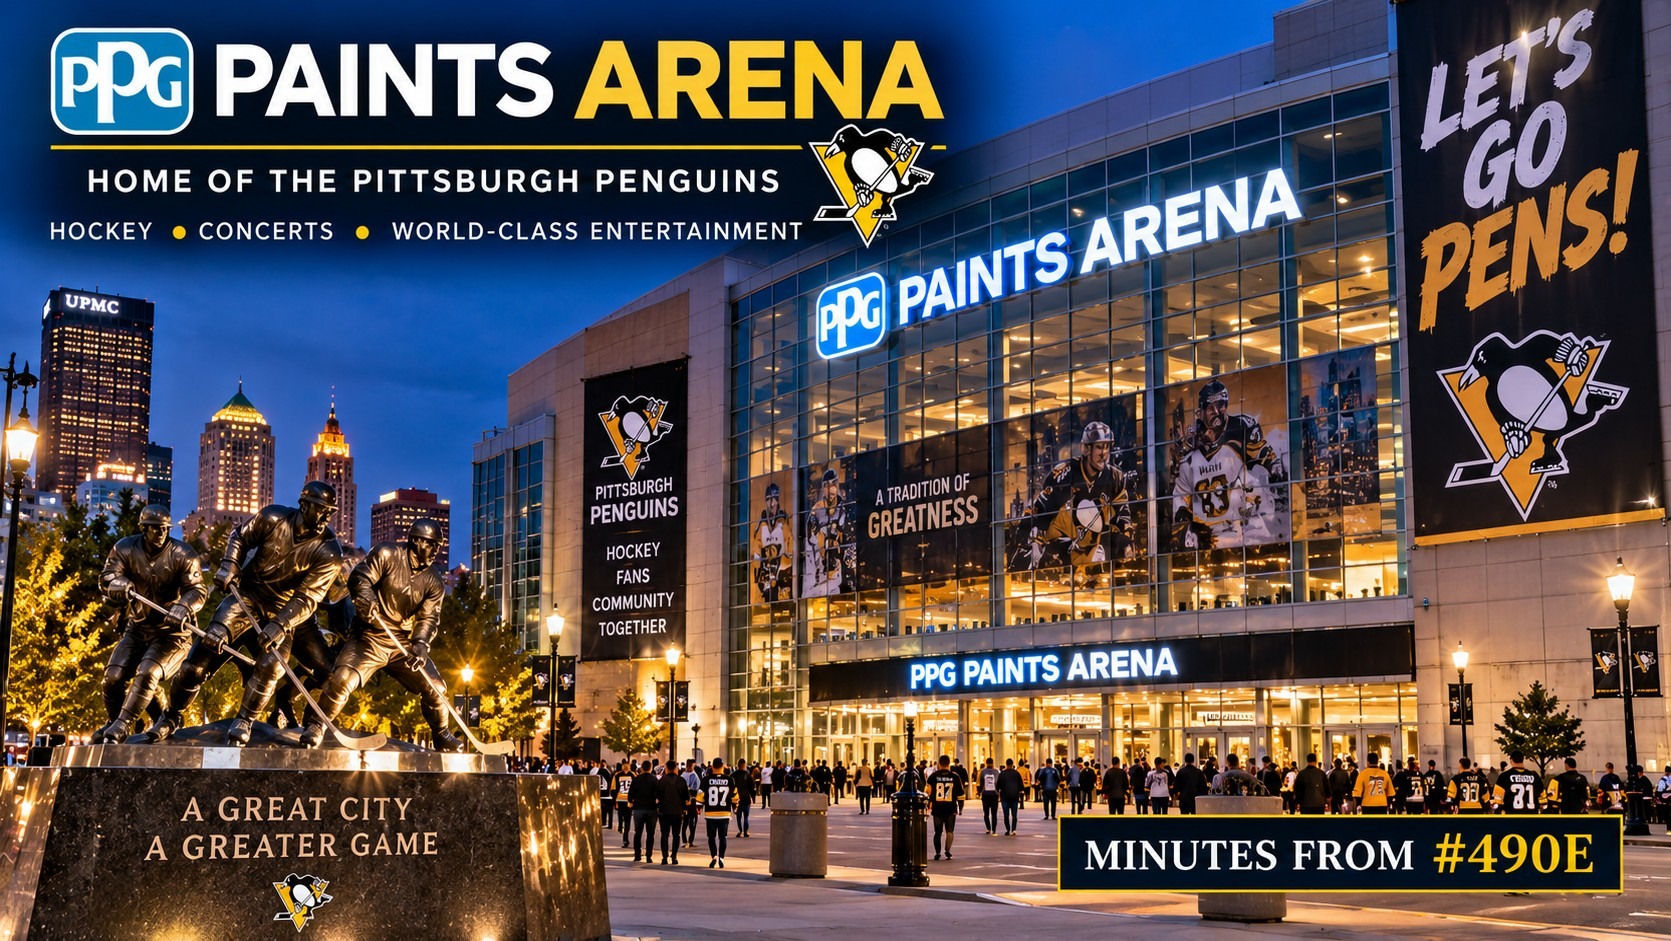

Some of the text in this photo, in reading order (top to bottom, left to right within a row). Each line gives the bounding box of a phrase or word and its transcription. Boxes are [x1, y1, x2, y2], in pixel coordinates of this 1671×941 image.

[1420, 8, 1594, 152] LET'S
[1463, 100, 1567, 210] GO
[1419, 148, 1639, 334] PENS!
[819, 167, 1302, 350] PPG PAINTS ARENA
[65, 293, 119, 314] UPMC
[595, 477, 673, 501] PITTSBURGH
[875, 472, 971, 506] A TRADITION OF
[590, 496, 679, 525] PENGUINS
[868, 495, 979, 539] GREATNESS
[606, 542, 661, 561] HOCKEY
[616, 568, 651, 585] FANS
[592, 592, 674, 612] COMMUNITY
[599, 618, 667, 637] TOGETHER
[910, 647, 1179, 689] PPG PAINTS ARENA
[180, 796, 413, 822] A GREAT CITY
[708, 786, 729, 806] 87
[144, 831, 439, 861] A GREATER GAME
